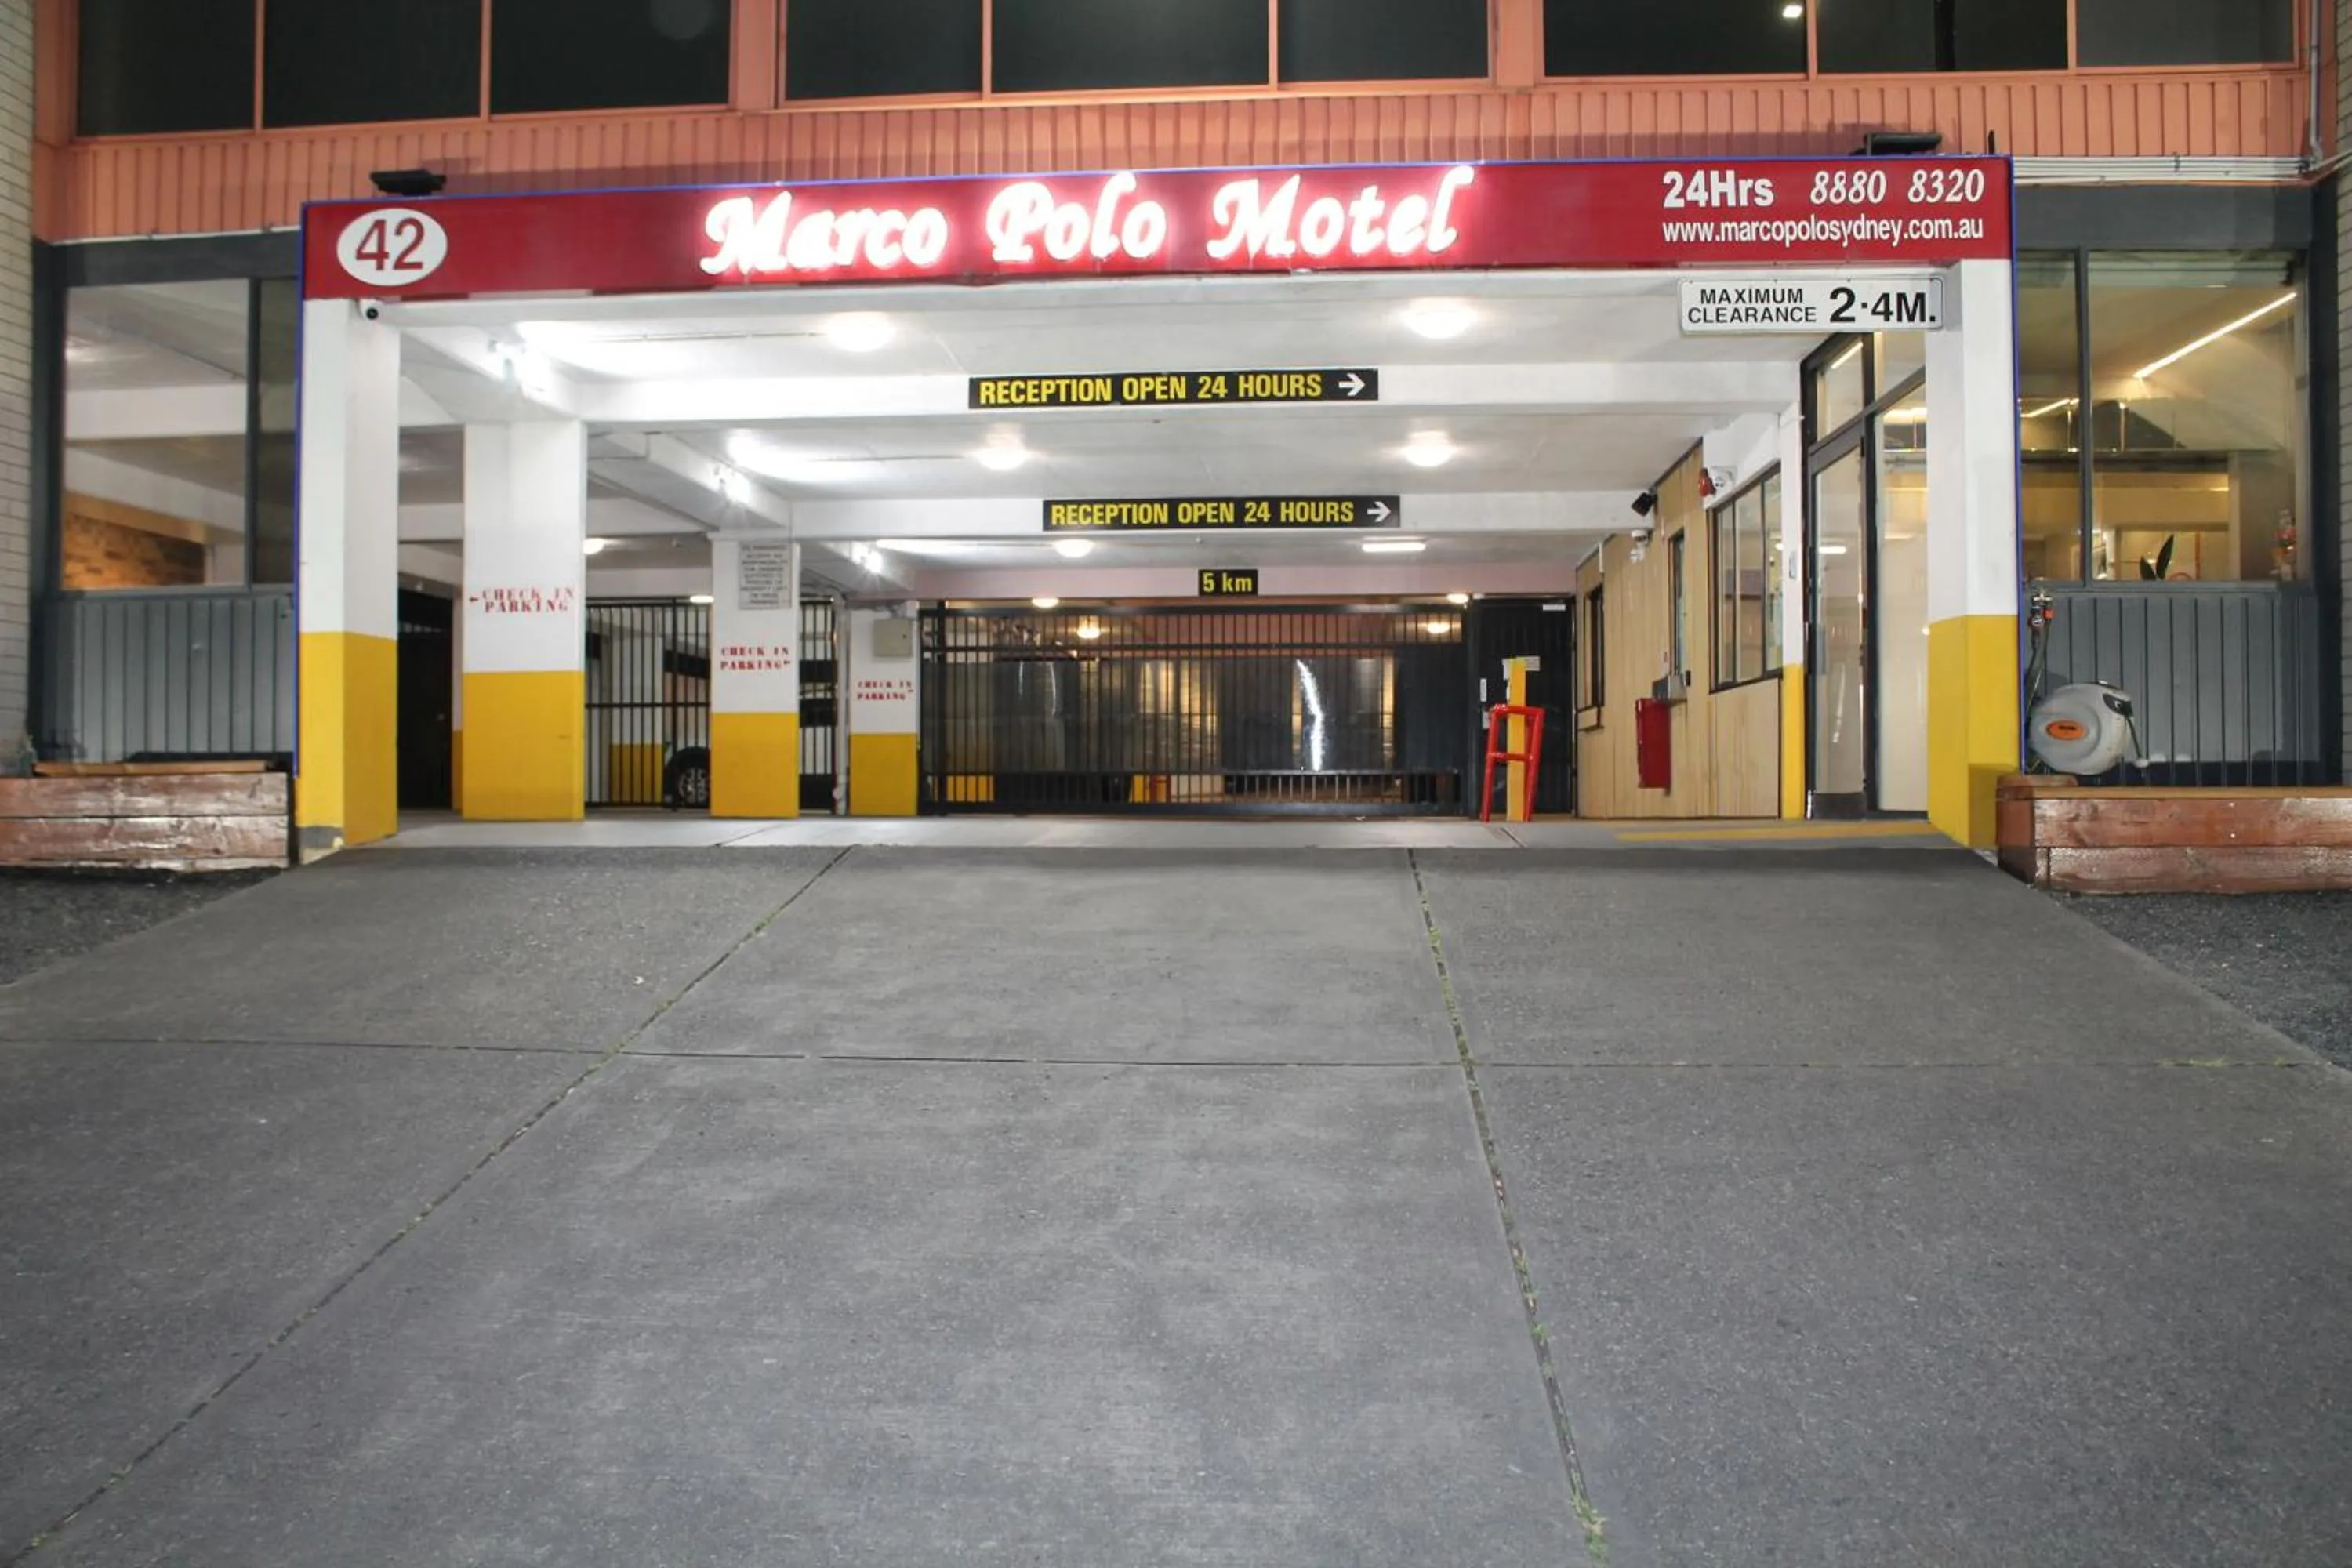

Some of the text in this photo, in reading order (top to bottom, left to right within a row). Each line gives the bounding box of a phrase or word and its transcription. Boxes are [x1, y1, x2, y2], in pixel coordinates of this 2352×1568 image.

[1662, 169, 1985, 208] 24Hrs 8880 8320
[699, 165, 1475, 274] Marco Polo Motel
[1662, 213, 1984, 249] www.marcopolosydney.com.au
[354, 217, 426, 272] 42
[1700, 288, 1804, 305] MAXIMUM
[1687, 307, 1817, 325] CLEARANCE
[978, 372, 1323, 405] RECEPTION OPEN 24 HOURS
[1051, 499, 1355, 526] RECEPTION OPEN 24 HOURS
[1203, 572, 1254, 593] 5 km
[481, 587, 575, 601] CHECK IN
[485, 599, 568, 613] PARKING
[720, 646, 765, 656] CHECK
[720, 660, 782, 671] PARKING
